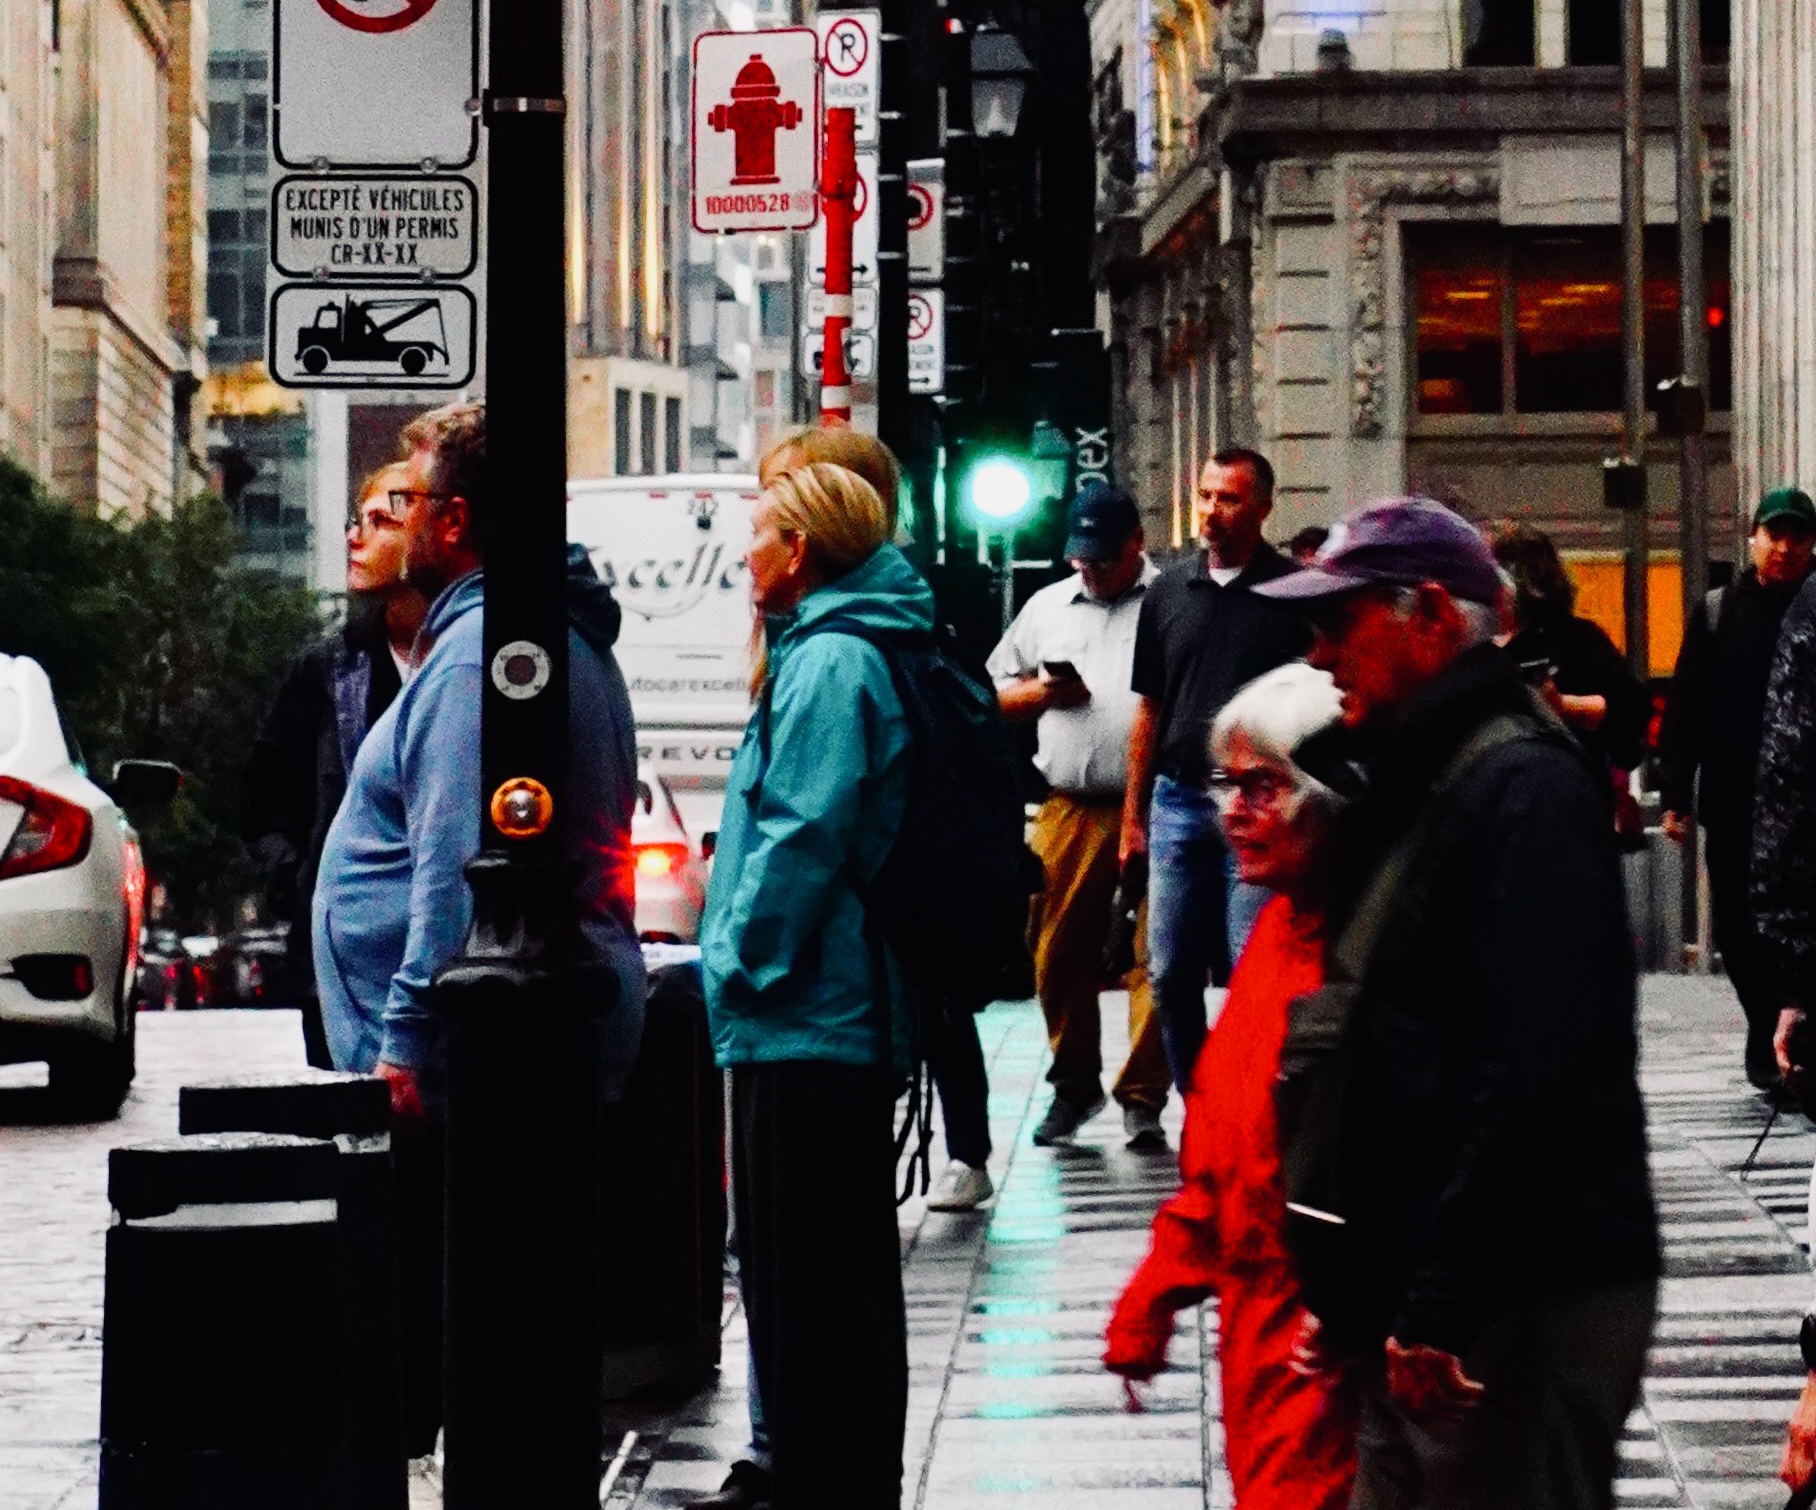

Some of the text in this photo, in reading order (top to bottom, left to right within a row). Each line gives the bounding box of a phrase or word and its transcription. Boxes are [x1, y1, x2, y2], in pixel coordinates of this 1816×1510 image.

[285, 184, 465, 211] EXCEPTÉ VÉHICULES
[290, 216, 460, 239] MUNIS D'UN PERMIS
[330, 242, 418, 265] CR-XX-XX
[637, 745, 736, 762] REVO
